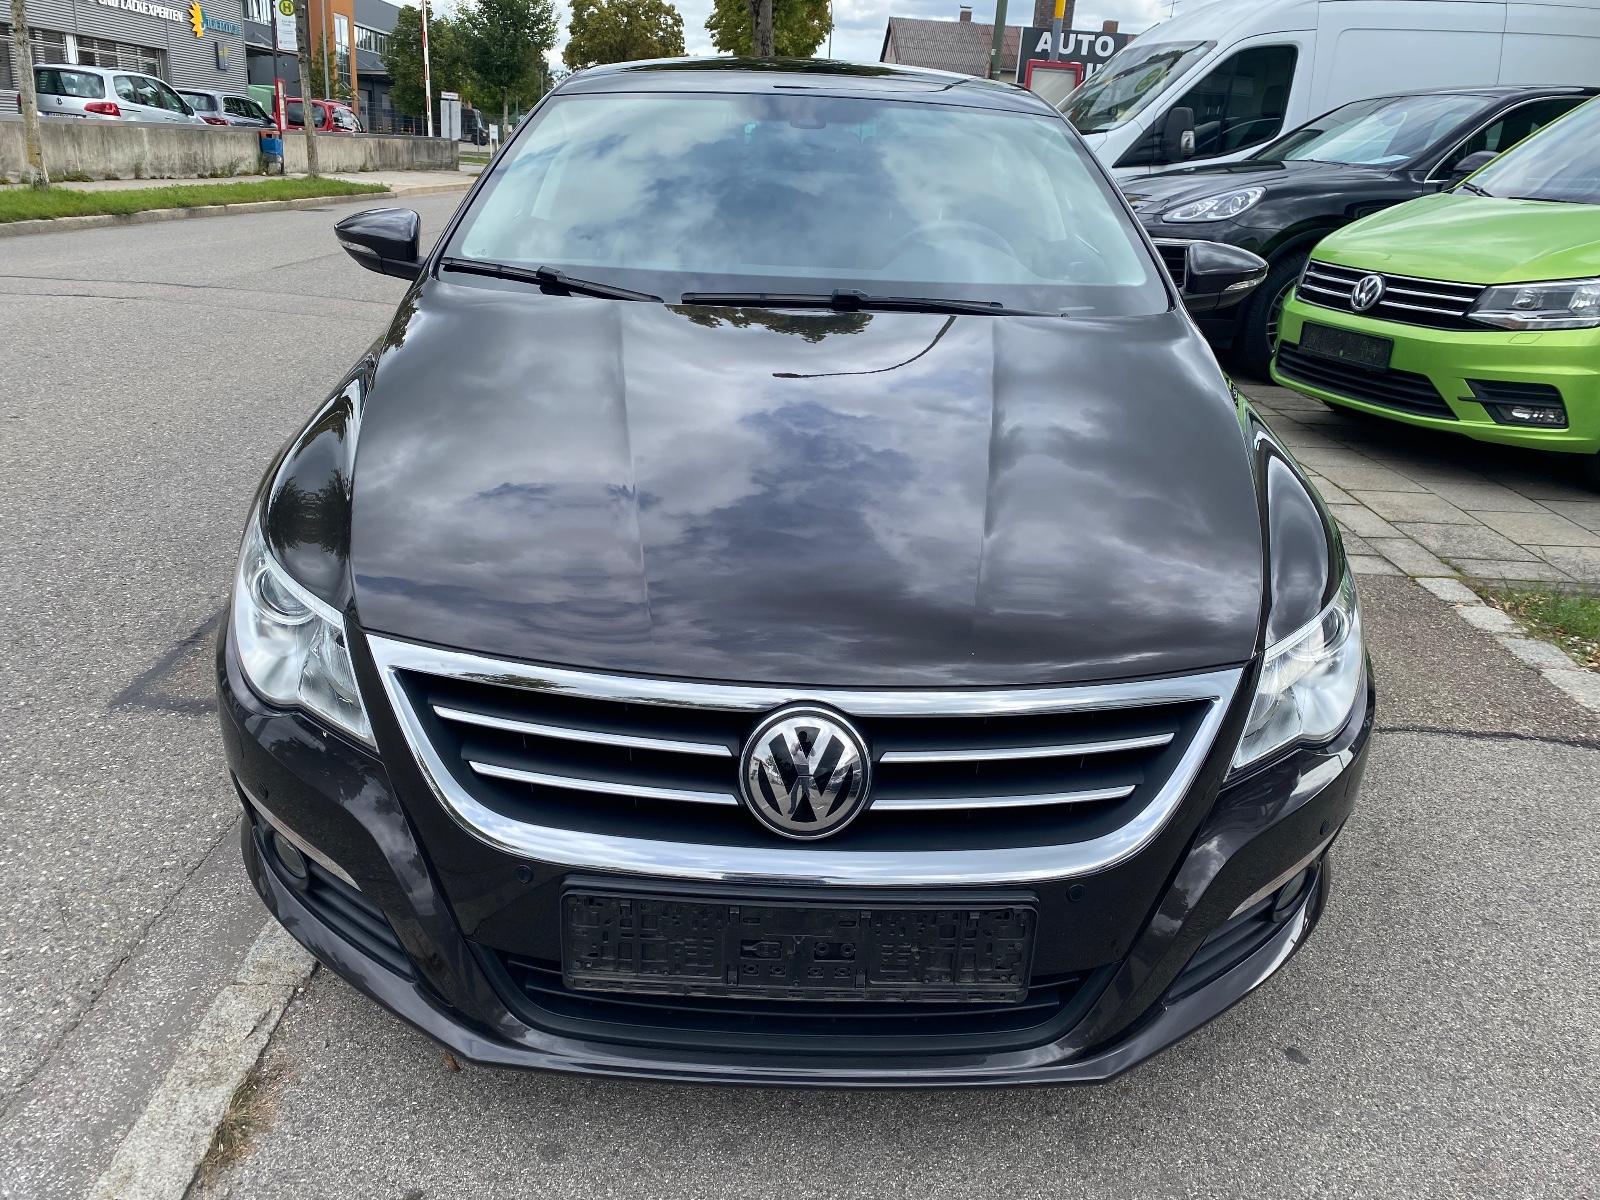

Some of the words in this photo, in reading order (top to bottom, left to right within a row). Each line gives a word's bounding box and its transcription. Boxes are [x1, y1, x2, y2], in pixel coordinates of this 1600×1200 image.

[120, 0, 184, 22] LACKEXPERTEN
[282, 2, 292, 13] H
[1035, 31, 1115, 57] AUTO
